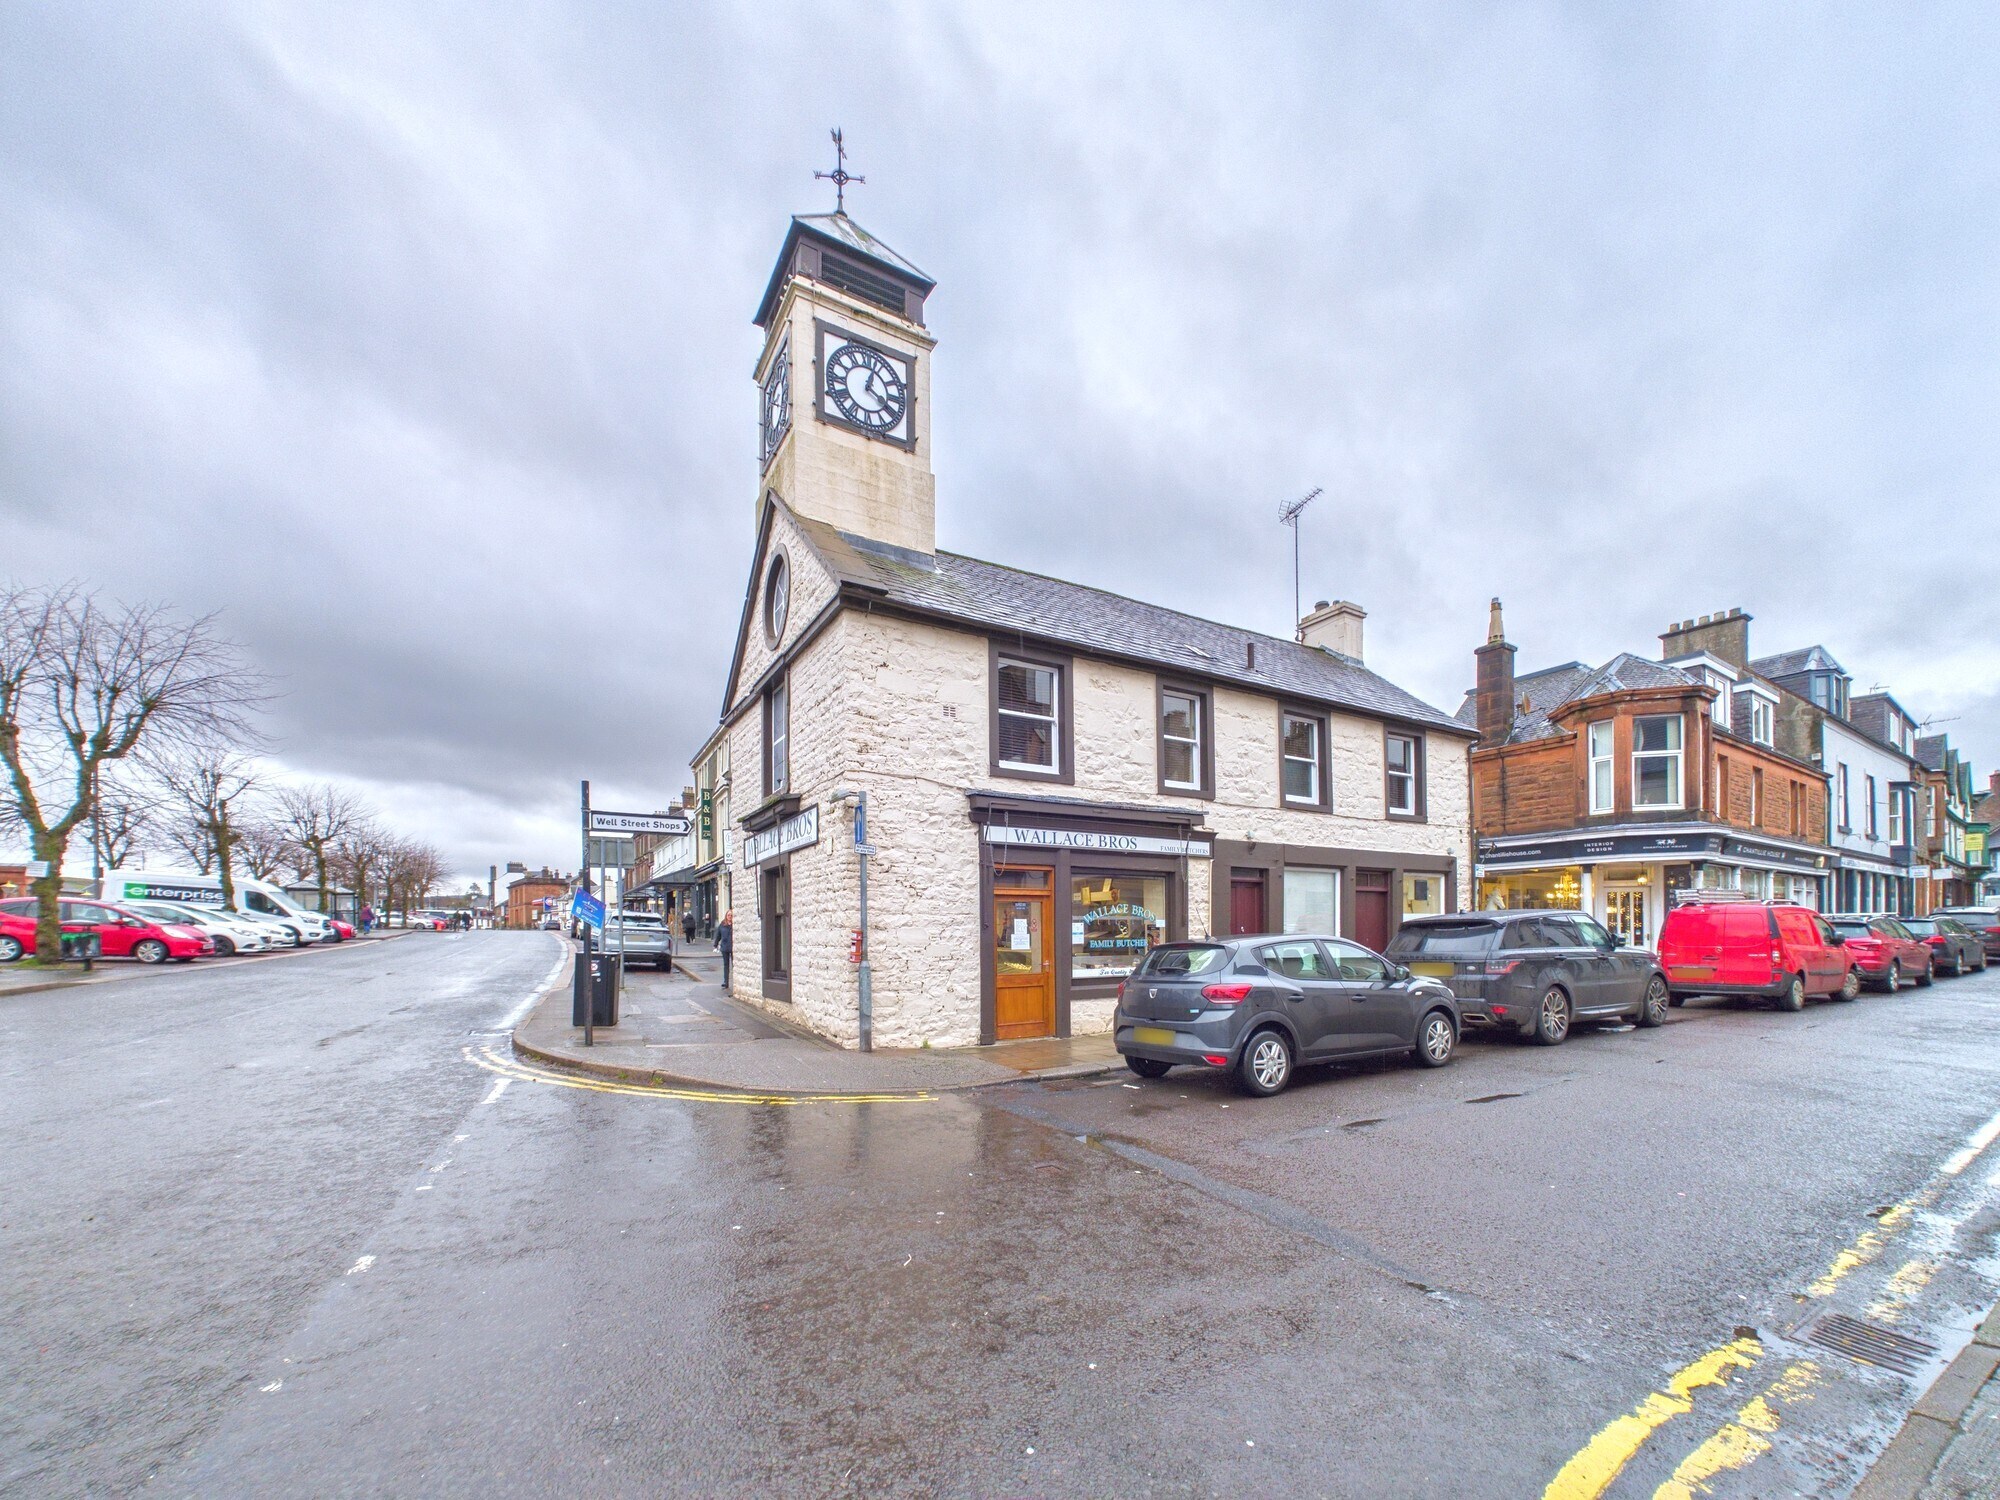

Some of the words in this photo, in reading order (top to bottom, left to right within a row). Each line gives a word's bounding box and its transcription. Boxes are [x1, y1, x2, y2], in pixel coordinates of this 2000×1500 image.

[704, 791, 710, 801] B
[703, 805, 710, 813] &
[596, 817, 617, 826] Well
[620, 819, 650, 828] Street
[653, 821, 680, 830] Shops
[704, 816, 710, 826] B
[786, 811, 813, 843] BROS
[1014, 828, 1094, 847] WALLACE
[1099, 835, 1137, 850] BROS
[1160, 845, 1180, 853] FAMILY
[1479, 849, 1542, 859] wchantilliehouse.com
[129, 886, 226, 899] enterprise
[1082, 903, 1129, 926] WALLACE
[1132, 905, 1157, 922] BROS
[1089, 940, 1114, 949] FAMILY
